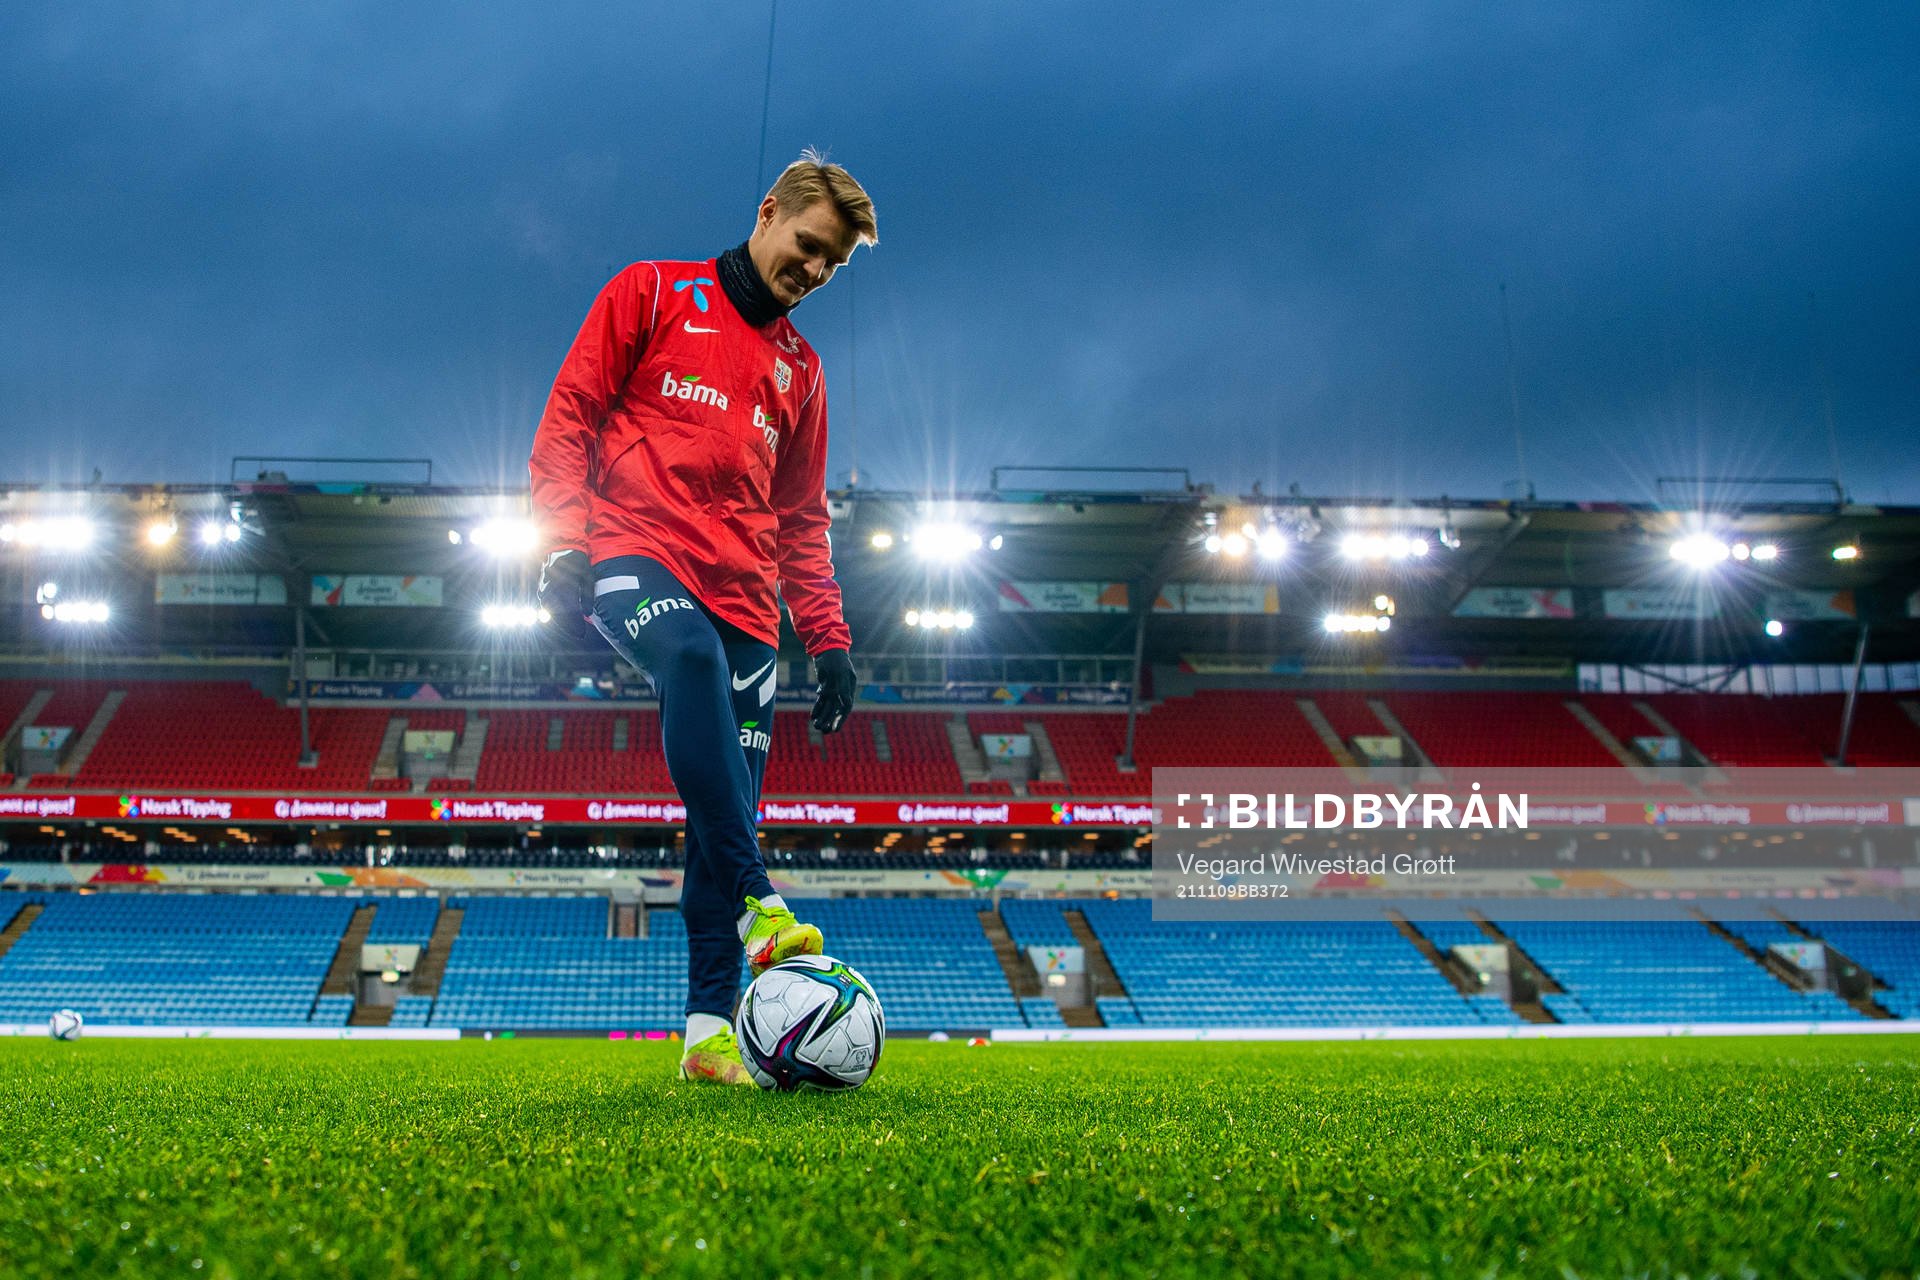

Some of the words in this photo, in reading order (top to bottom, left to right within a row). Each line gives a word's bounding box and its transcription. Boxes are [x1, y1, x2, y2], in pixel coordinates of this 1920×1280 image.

[661, 371, 728, 411] bama
[752, 404, 779, 454] bm
[624, 598, 695, 640] bama
[739, 728, 771, 753] am
[141, 798, 181, 815] Norsk
[181, 798, 232, 819] Tipping
[453, 801, 494, 818] Norsk
[493, 801, 544, 821] Tipping
[765, 804, 805, 820] Norsk
[804, 804, 856, 823] Tipping
